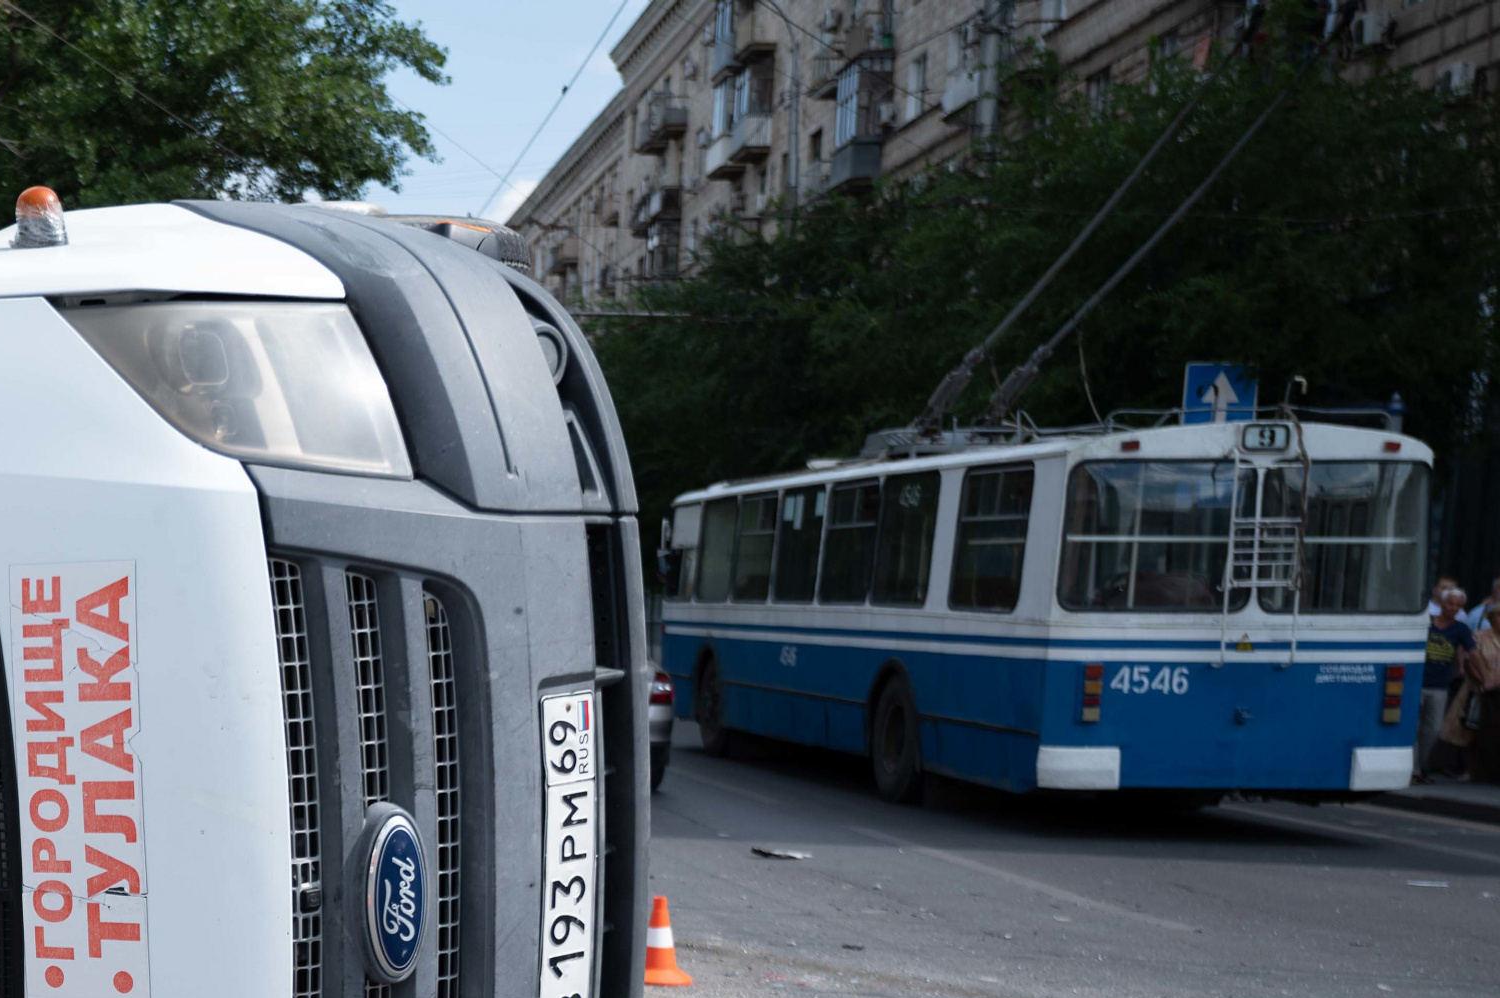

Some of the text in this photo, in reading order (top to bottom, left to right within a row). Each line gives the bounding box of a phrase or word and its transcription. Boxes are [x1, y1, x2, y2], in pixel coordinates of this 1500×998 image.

[1259, 427, 1276, 447] 9
[1109, 665, 1190, 695] 4546
[549, 719, 579, 777] 69
[578, 732, 590, 776] RUS
[382, 856, 417, 942] Ford
